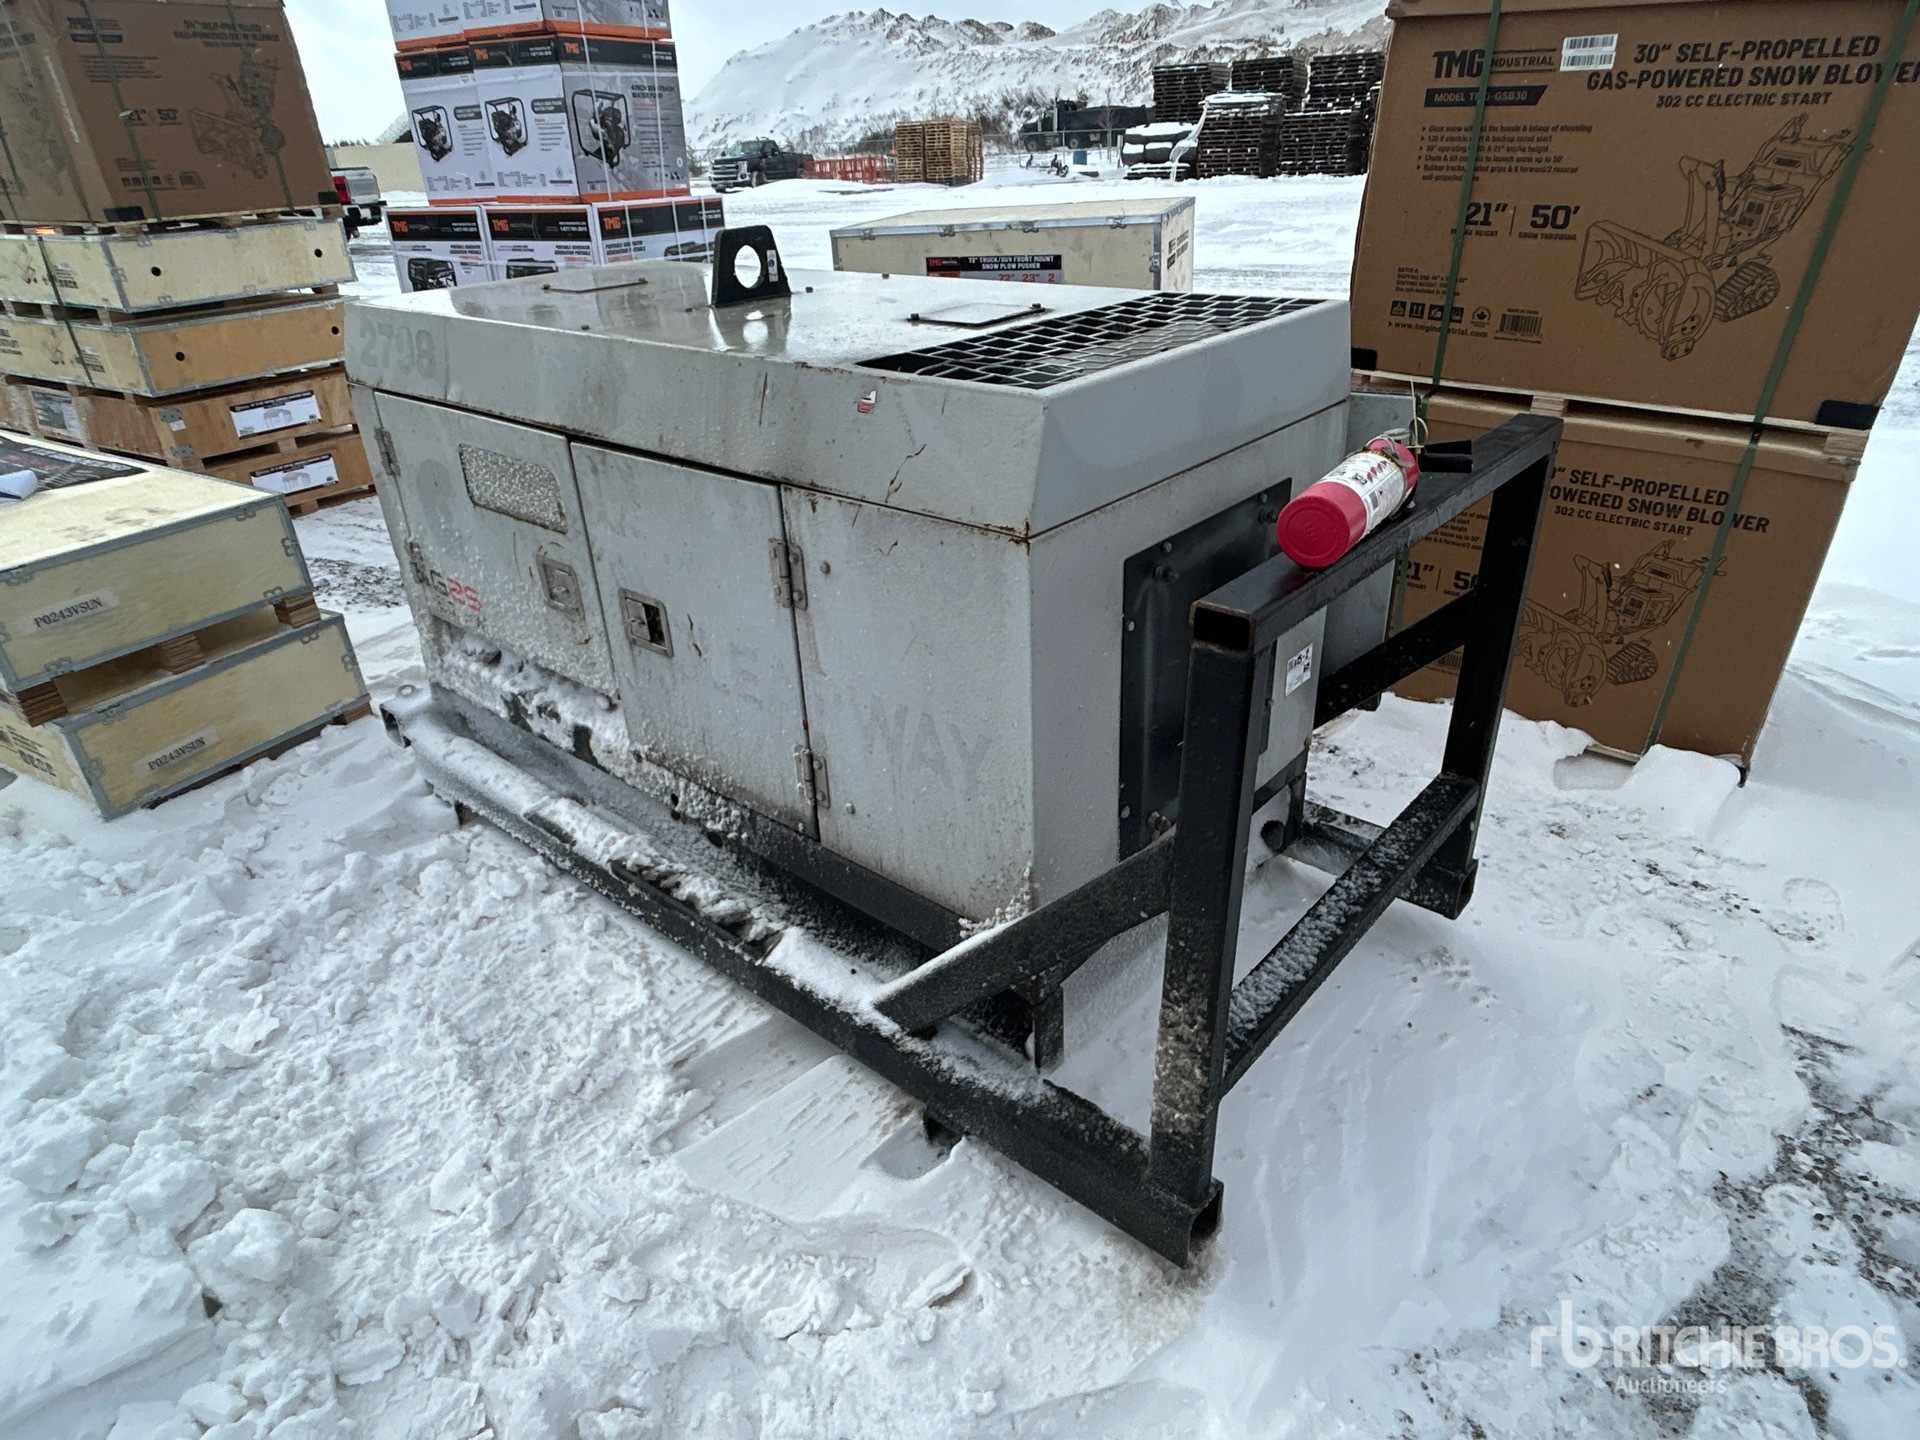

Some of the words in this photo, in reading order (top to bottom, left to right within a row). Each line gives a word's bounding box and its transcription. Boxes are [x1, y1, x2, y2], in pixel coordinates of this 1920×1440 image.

[1634, 44, 1671, 63] 30"
[1676, 35, 1881, 63] SELF-PROPELLED
[1433, 49, 1485, 78] TMG
[1490, 55, 1555, 68] NDUSTRIAL
[1587, 66, 1744, 90] GAS-POWERED
[1748, 64, 1821, 87] SNOW
[1434, 93, 1465, 102] MODEL
[1469, 91, 1527, 101] T-GSB30
[1656, 95, 1681, 108] 302
[1685, 94, 1704, 107] CC
[1706, 92, 1776, 107] ELECTRIC
[1780, 92, 1832, 105] START
[1465, 202, 1508, 225] 21"
[1530, 204, 1580, 229] 50'
[1395, 321, 1488, 338] www.tmgindstrial.com
[1569, 469, 1730, 506] SELF-PROPELLED
[1550, 485, 1623, 510] OWERED
[1627, 497, 1684, 519] SNOW
[1554, 505, 1575, 517] 302
[1577, 509, 1592, 519] CC
[1595, 512, 1650, 529] ELECTRIC
[1652, 522, 1694, 536] START
